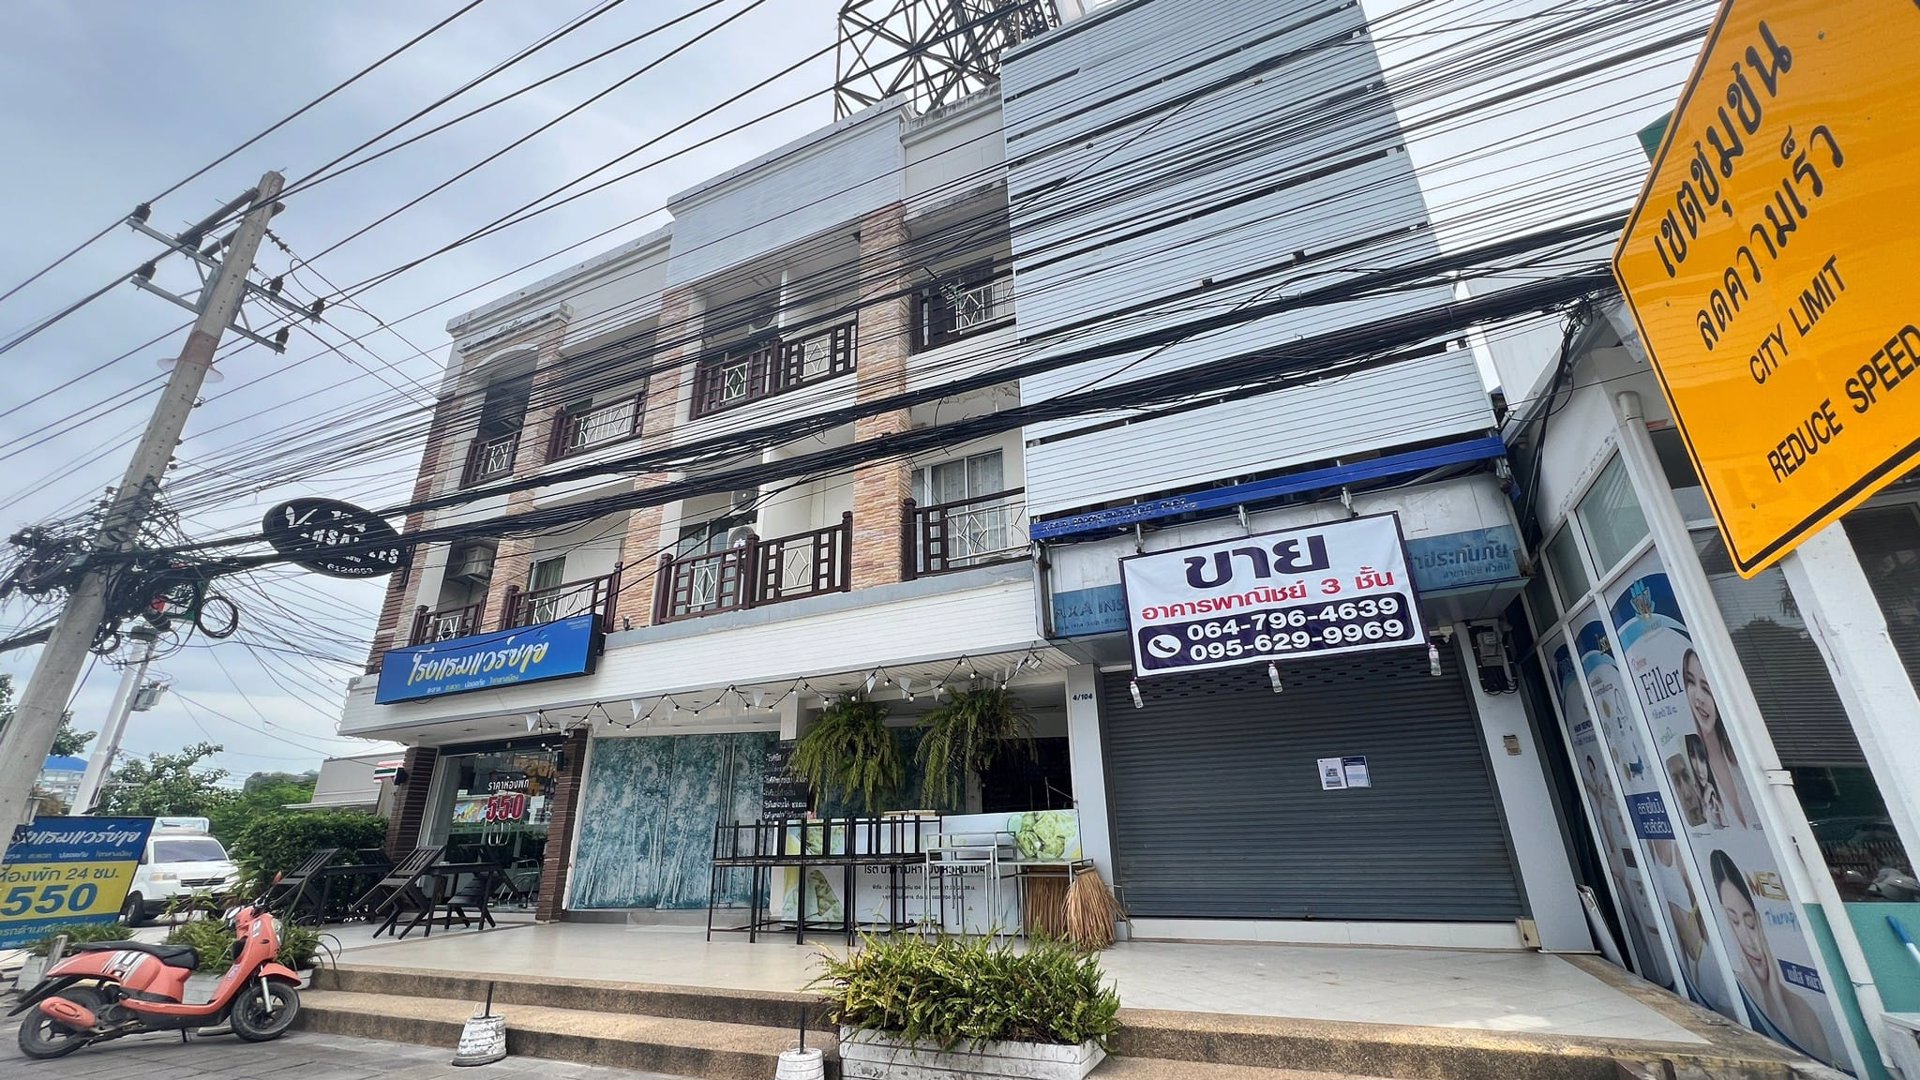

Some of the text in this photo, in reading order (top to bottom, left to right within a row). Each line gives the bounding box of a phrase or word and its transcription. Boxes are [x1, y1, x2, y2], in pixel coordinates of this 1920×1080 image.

[1653, 20, 1793, 279] เขตชุมชน
[1695, 124, 1844, 352] ลดความเร็ว
[1748, 255, 1847, 386] CITY LIMIT
[1766, 323, 1920, 484] REDUCE SPEED
[1184, 534, 1331, 589] ขาย
[1142, 566, 1395, 621] อาคารพาณิชย์ 3 ชั้น
[1187, 596, 1399, 642] 064-796-4639
[1190, 618, 1405, 661] 095-629-9969
[1639, 665, 1684, 706] Filler
[485, 793, 524, 822] 550
[65, 867, 89, 880] 24
[93, 867, 119, 880] ชม.
[1, 883, 98, 917] 550
